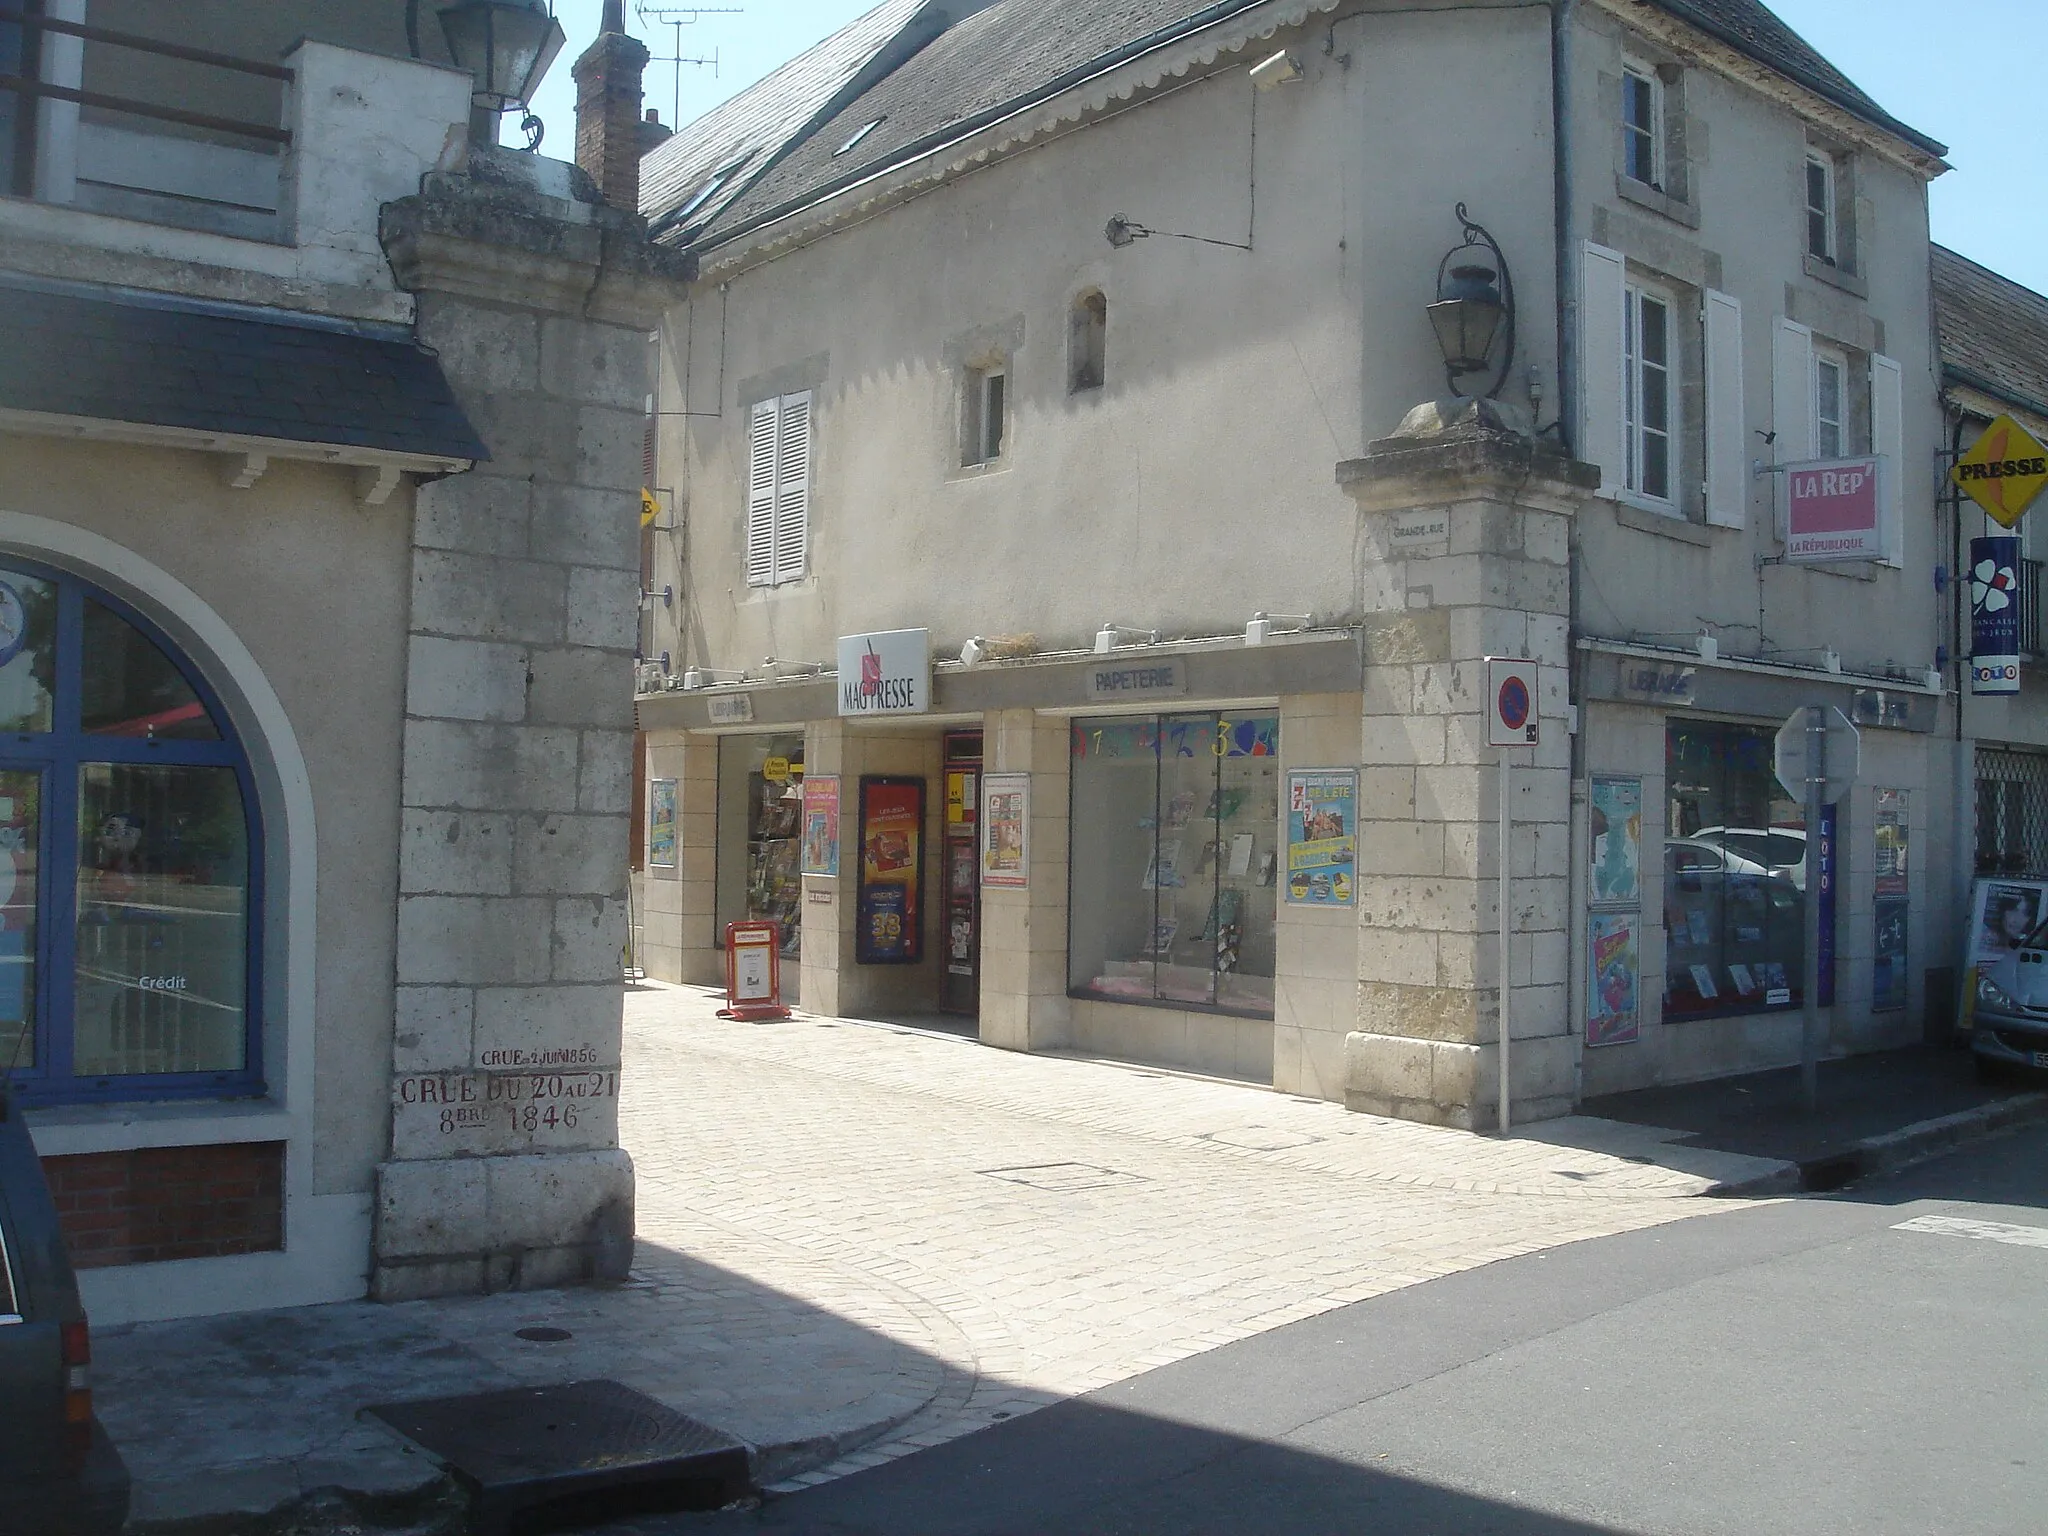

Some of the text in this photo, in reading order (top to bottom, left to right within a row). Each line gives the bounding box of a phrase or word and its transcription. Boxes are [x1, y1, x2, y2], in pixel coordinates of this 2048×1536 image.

[1959, 457, 2046, 481] PRESSE
[1795, 477, 1817, 498] LA
[1790, 538, 1864, 553] LA RÉPUBLIQUE
[1096, 667, 1174, 691] PAPETERIE
[1973, 665, 2016, 681] LOTO
[844, 678, 914, 710] MAG PRESSE
[1820, 819, 1830, 892] LOTO
[139, 976, 186, 989] Crédit
[481, 1050, 522, 1065] CRUE
[530, 1052, 538, 1064] 2
[401, 1072, 614, 1103] CRUE DU 20 AU 21
[510, 1103, 578, 1132] 1846
